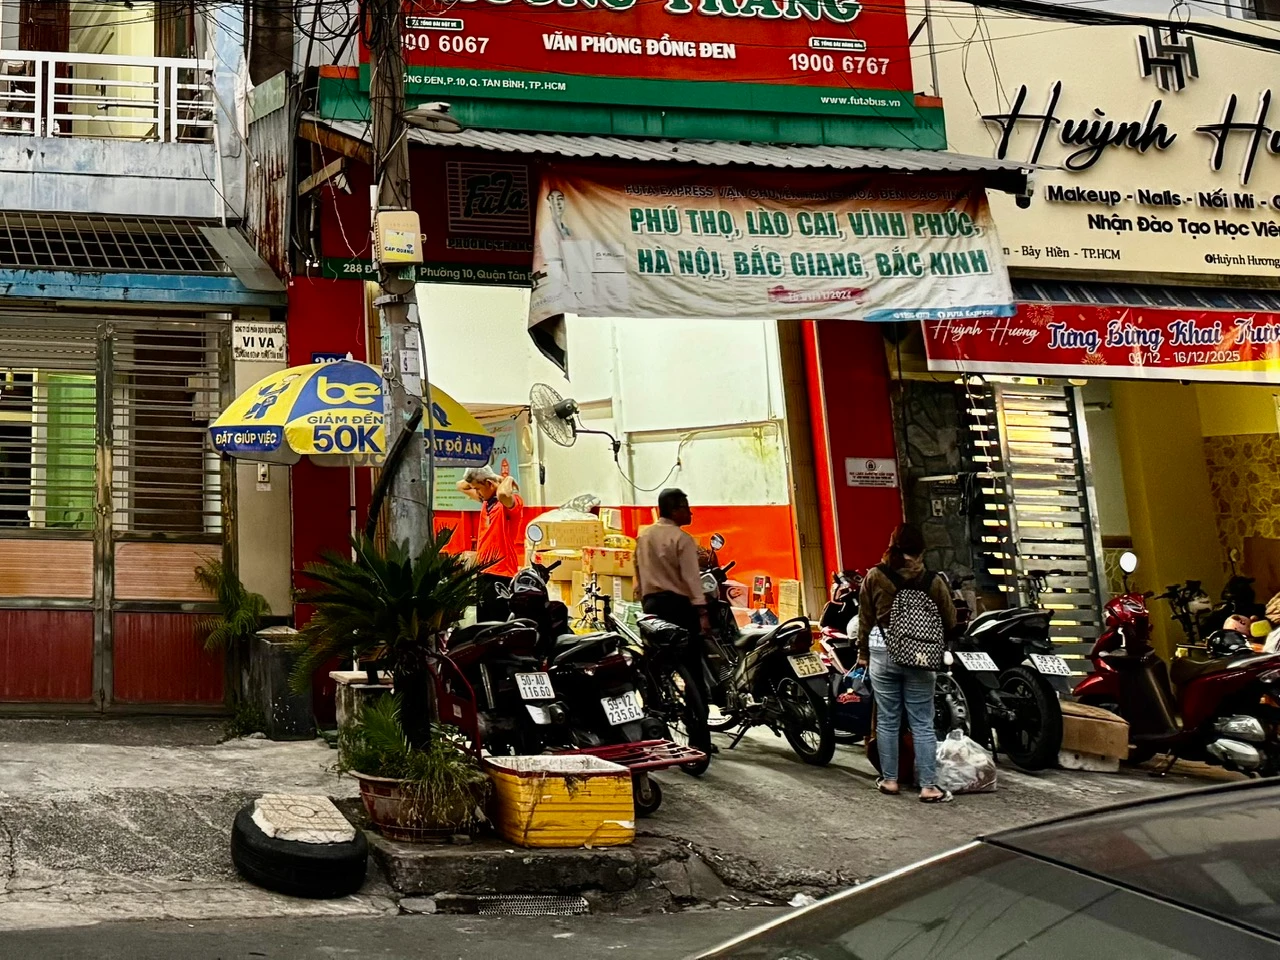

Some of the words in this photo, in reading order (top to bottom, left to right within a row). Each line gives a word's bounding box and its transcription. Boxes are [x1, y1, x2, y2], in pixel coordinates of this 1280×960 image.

[438, 35, 490, 54] 6067
[542, 31, 577, 52] VĂN
[580, 32, 642, 56] PHÒNG
[646, 33, 696, 59] ĐỒNG
[699, 41, 737, 60] ĐEN
[788, 53, 834, 73] 1900
[842, 55, 890, 76] 6767
[529, 81, 566, 90] TP.HCM
[820, 95, 901, 107] www.futabus.vn
[980, 80, 1178, 172] Huỳnh
[660, 185, 715, 198] EXPRESS
[1045, 185, 1122, 207] Makeup
[1136, 188, 1182, 207] Nails
[1196, 188, 1229, 209] Nối
[1232, 193, 1255, 209] Mi
[629, 204, 681, 235] PHÚ
[745, 206, 792, 237] LÀO
[796, 210, 844, 240] CAI,
[847, 208, 908, 238] VĨNH
[911, 207, 981, 239] PHÚC,
[1087, 213, 1134, 235] Nhận
[1136, 215, 1174, 234] Đào
[1177, 218, 1211, 239] Tạo
[1214, 220, 1250, 240] Học
[1252, 221, 1280, 238] Viê
[1021, 246, 1041, 259] Bảy
[1046, 246, 1070, 259] Hiền
[1081, 248, 1121, 260] TP.HCM
[1213, 253, 1247, 266] Huỳnh
[343, 263, 363, 274] 288
[637, 246, 674, 276] HÀ
[678, 246, 730, 282] NỘI,
[733, 244, 784, 278] BẮC
[789, 251, 870, 283] GIANG,
[875, 244, 924, 279] BẮC
[420, 266, 461, 280] Phường
[462, 268, 476, 280] 10,
[477, 269, 506, 282] Quận
[507, 269, 527, 281] Tân
[929, 318, 983, 344] Huỳnh
[985, 318, 1040, 346] Hương
[1105, 321, 1165, 351] Bừng
[1167, 319, 1224, 347] Khai
[242, 336, 255, 348] VI
[258, 337, 275, 348] VA
[1173, 351, 1241, 364] 16/12/2025
[316, 376, 382, 405] be
[307, 412, 350, 425] GIẢM
[352, 411, 384, 425] ĐẾN
[215, 431, 234, 446] ĐẶT
[234, 430, 258, 446] GIÚP
[259, 429, 277, 446] VIỆC
[312, 425, 383, 454] 50K
[446, 435, 463, 452] ĐỒ
[464, 439, 482, 455] ĂN
[522, 686, 552, 698] 116.60
[607, 695, 634, 711] 59-V2
[609, 708, 641, 723] 235.64
